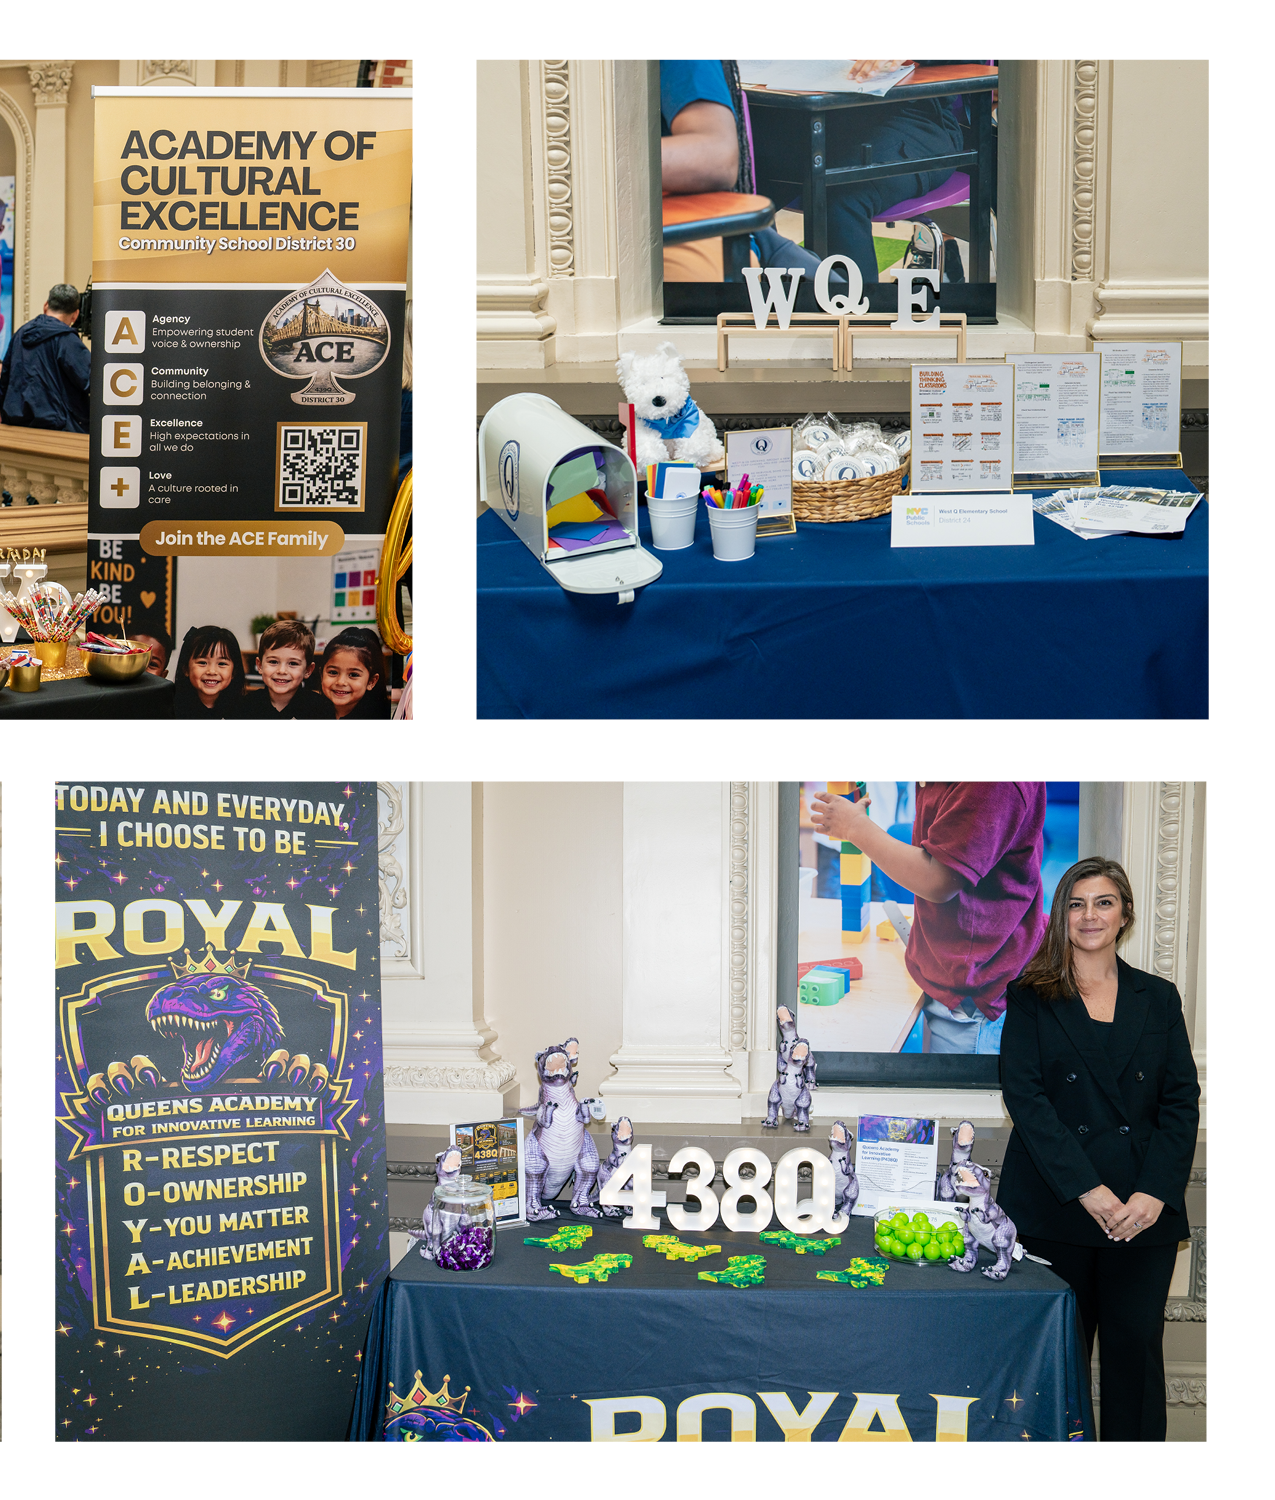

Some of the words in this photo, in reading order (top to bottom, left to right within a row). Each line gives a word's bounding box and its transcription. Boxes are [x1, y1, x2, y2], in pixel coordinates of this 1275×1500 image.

[120, 129, 318, 160] ACADEMY
[324, 129, 377, 161] OF
[120, 165, 321, 196] CULTURAL
[120, 201, 360, 231] EXCELLENCE
[119, 236, 217, 255] Community
[218, 236, 273, 251] School
[275, 236, 334, 251] District
[335, 237, 356, 251] 30
[272, 294, 299, 320] ACADEMY
[299, 291, 308, 299] OF
[308, 287, 343, 296] CULTURAL
[344, 290, 380, 318] EXCELLENCE
[152, 314, 191, 325] Agency
[111, 317, 139, 345] A
[152, 327, 214, 338] Empowering
[215, 327, 254, 337] student
[151, 339, 180, 348] voice
[180, 340, 188, 348] &
[189, 340, 241, 349] ownership
[293, 341, 355, 363] ACE
[151, 366, 210, 377] Community
[110, 368, 138, 398] C
[151, 380, 191, 390] Building
[192, 380, 242, 390] belonging
[244, 380, 251, 389] &
[150, 392, 207, 400] connection
[150, 418, 203, 428] Excellence
[113, 421, 131, 449] E
[149, 431, 172, 441] High
[174, 431, 239, 441] expectations
[241, 431, 250, 440] in
[755, 439, 768, 451] Q
[149, 443, 162, 452] all
[163, 444, 178, 452] we
[180, 443, 194, 452] do
[149, 471, 173, 480] Love
[148, 484, 155, 493] A
[157, 484, 192, 493] culture
[195, 484, 227, 493] rooted
[229, 484, 239, 493] in
[148, 496, 171, 504] care
[906, 507, 929, 515] NYC
[99, 540, 123, 560] BE
[155, 531, 193, 546] Join
[196, 531, 226, 546] the
[229, 531, 264, 546] ACE
[267, 531, 329, 550] Family
[91, 560, 135, 582] KIND
[99, 583, 122, 604] BE
[92, 605, 132, 625] YOU!
[55, 785, 145, 813] TODAY
[152, 790, 208, 816] AND
[217, 793, 350, 831] EVERYDAY,
[99, 820, 107, 847] I
[117, 821, 225, 851] CHOOSE
[233, 826, 266, 853] TO
[275, 830, 308, 855] BE
[55, 898, 357, 971] ROYAL
[106, 1096, 203, 1122] QUEENS
[209, 1095, 319, 1114] ACADEMY
[112, 1124, 146, 1138] FOR
[151, 1118, 242, 1135] INNOVATIVE
[246, 1115, 317, 1129] LEARNING
[474, 1149, 498, 1160] 438Q
[861, 1155, 880, 1163] Learning
[599, 1143, 849, 1234] 438Q
[219, 1205, 310, 1234] MATTER
